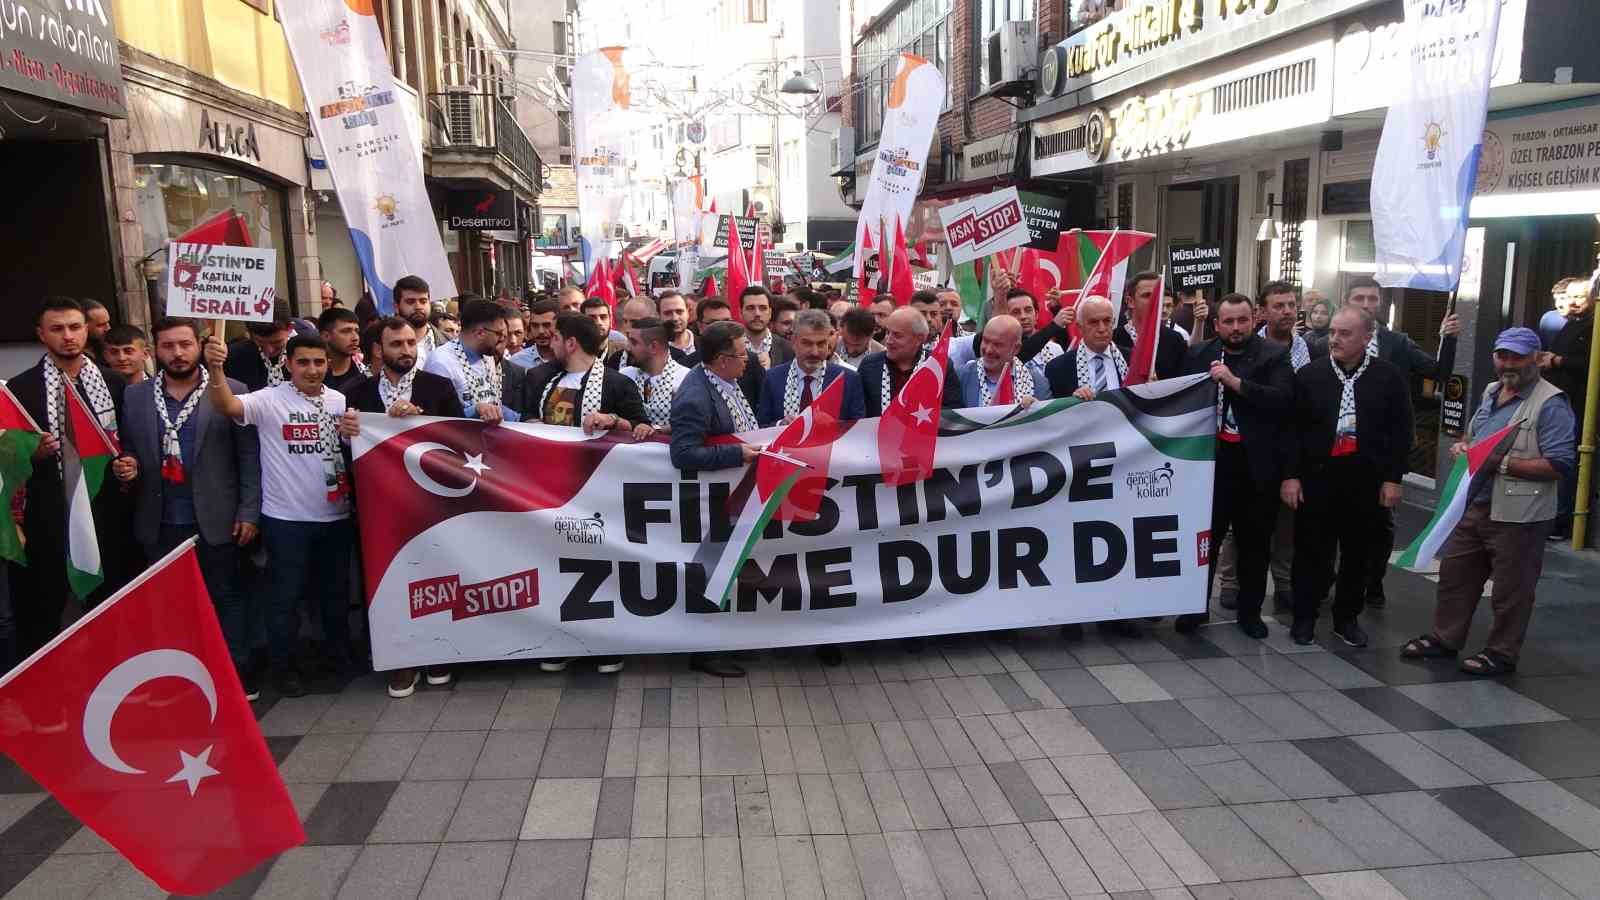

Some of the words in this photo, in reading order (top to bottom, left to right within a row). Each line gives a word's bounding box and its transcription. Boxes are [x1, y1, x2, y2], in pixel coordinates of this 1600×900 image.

[1512, 129, 1546, 143] TRABZON
[1536, 143, 1585, 162] TRABZON
[1546, 165, 1590, 188] GELİŞİM
[1023, 204, 1061, 219] LARDAN
[950, 217, 976, 244] #SAY
[977, 204, 1019, 238] STOP!
[1172, 247, 1220, 262] MÜSLÜMAN
[1172, 264, 1197, 275] ZULME
[1197, 262, 1222, 273] BOYUN
[202, 271, 242, 282] KATİLİN
[192, 283, 236, 295] PARMAK
[238, 285, 251, 295] İZİ
[190, 296, 251, 316] İSRAİL
[1137, 486, 1169, 499] kolları
[566, 530, 602, 545] kolları
[558, 546, 857, 622] ZULME
[878, 525, 1052, 604] DUR
[1072, 514, 1182, 584] DE
[411, 581, 458, 610] #SAY
[463, 575, 533, 613] STOP!
